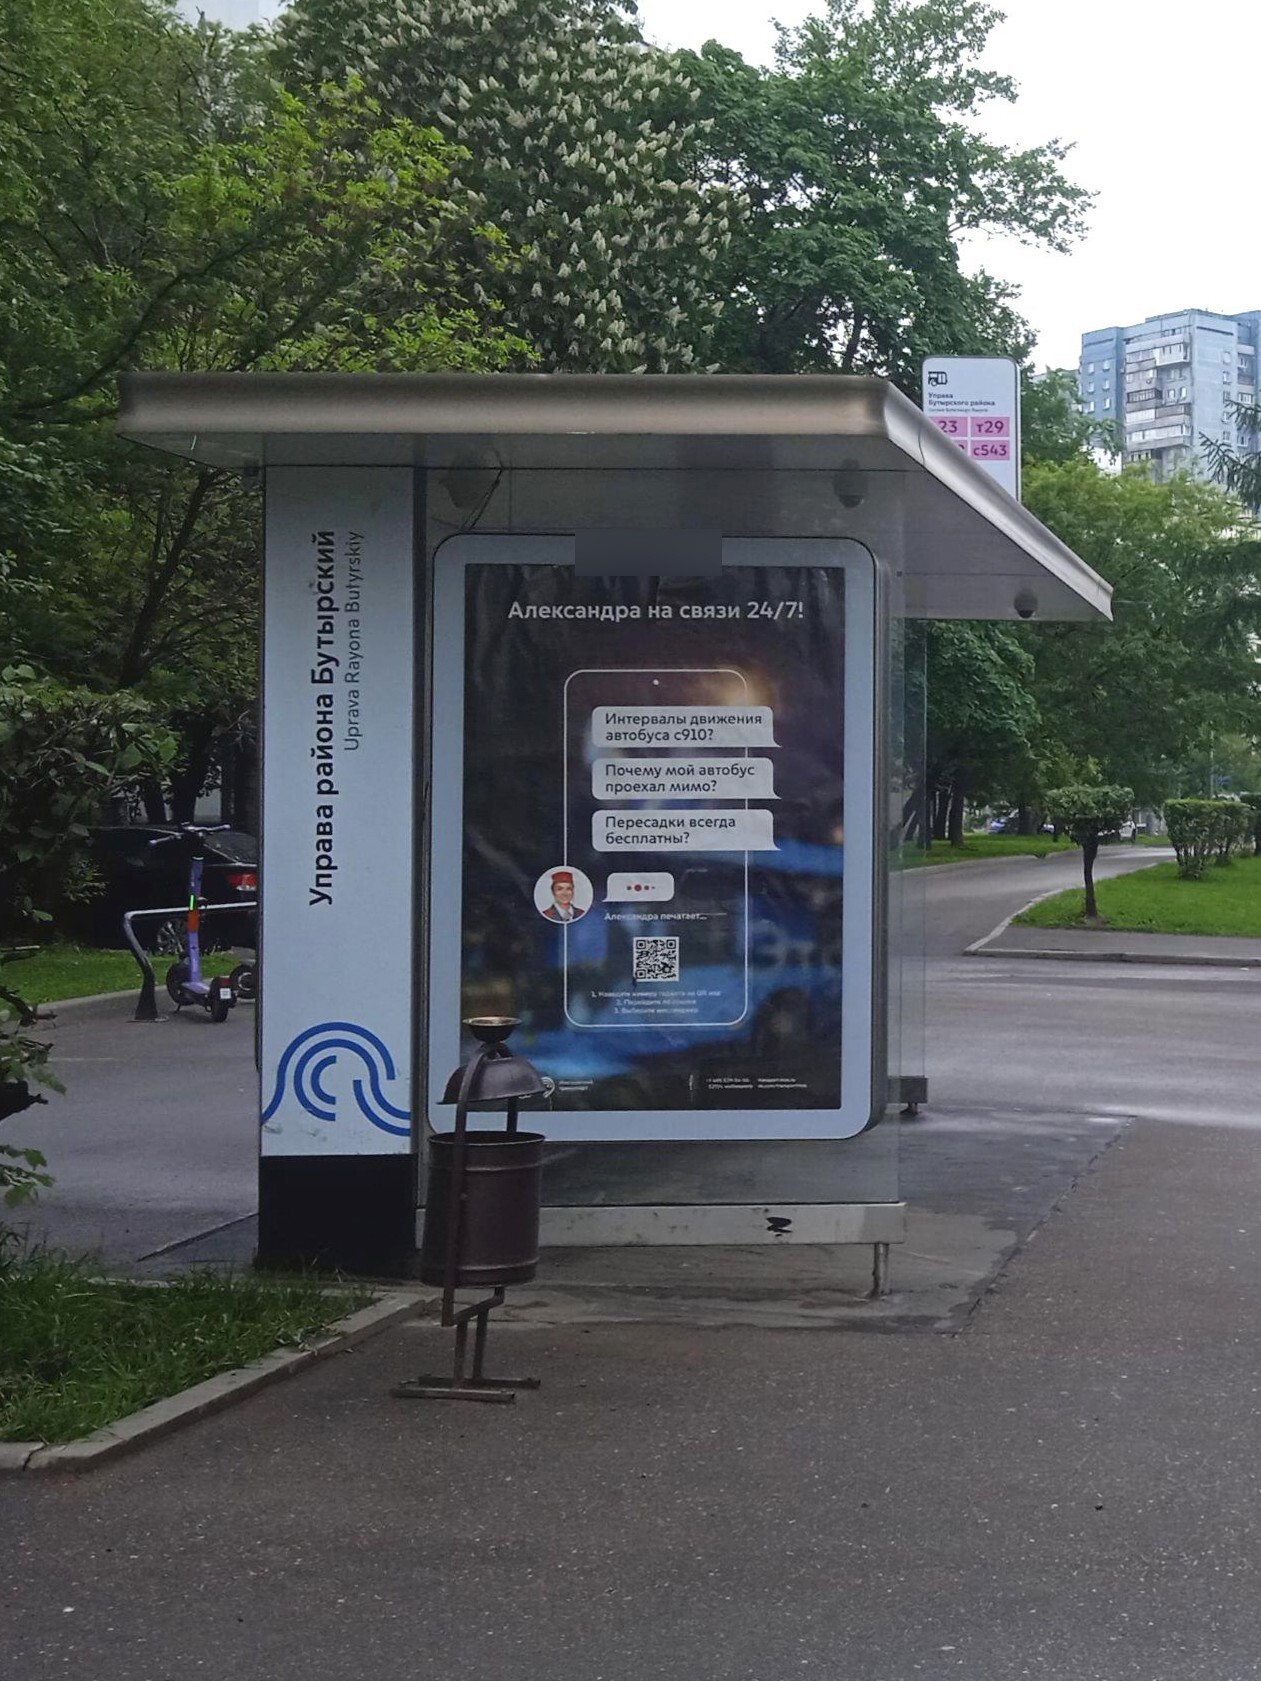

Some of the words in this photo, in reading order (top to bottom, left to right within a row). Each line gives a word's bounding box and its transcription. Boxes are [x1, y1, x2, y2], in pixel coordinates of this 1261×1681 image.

[344, 531, 366, 613] Butyrskiy
[310, 530, 340, 684] Бутырский
[508, 601, 641, 622] Александра
[648, 605, 673, 619] на
[680, 605, 740, 619] связи
[747, 601, 804, 619] 24/7!
[344, 618, 364, 684] Rayona
[344, 689, 364, 751] Uprava
[605, 713, 687, 726] Интервалы
[689, 714, 762, 727] движения
[310, 693, 339, 795] района
[605, 728, 669, 743] автобуса
[674, 728, 713, 741] с910?
[605, 764, 662, 778] Почему
[665, 764, 695, 776] мой
[699, 763, 755, 776] автобус
[605, 781, 665, 794] проехал
[669, 780, 717, 792] мимо?
[605, 816, 685, 830] Пересадки
[689, 818, 736, 829] всегда
[605, 831, 690, 846] бесплатны?
[309, 804, 338, 906] Управа
[604, 912, 658, 922] Александра
